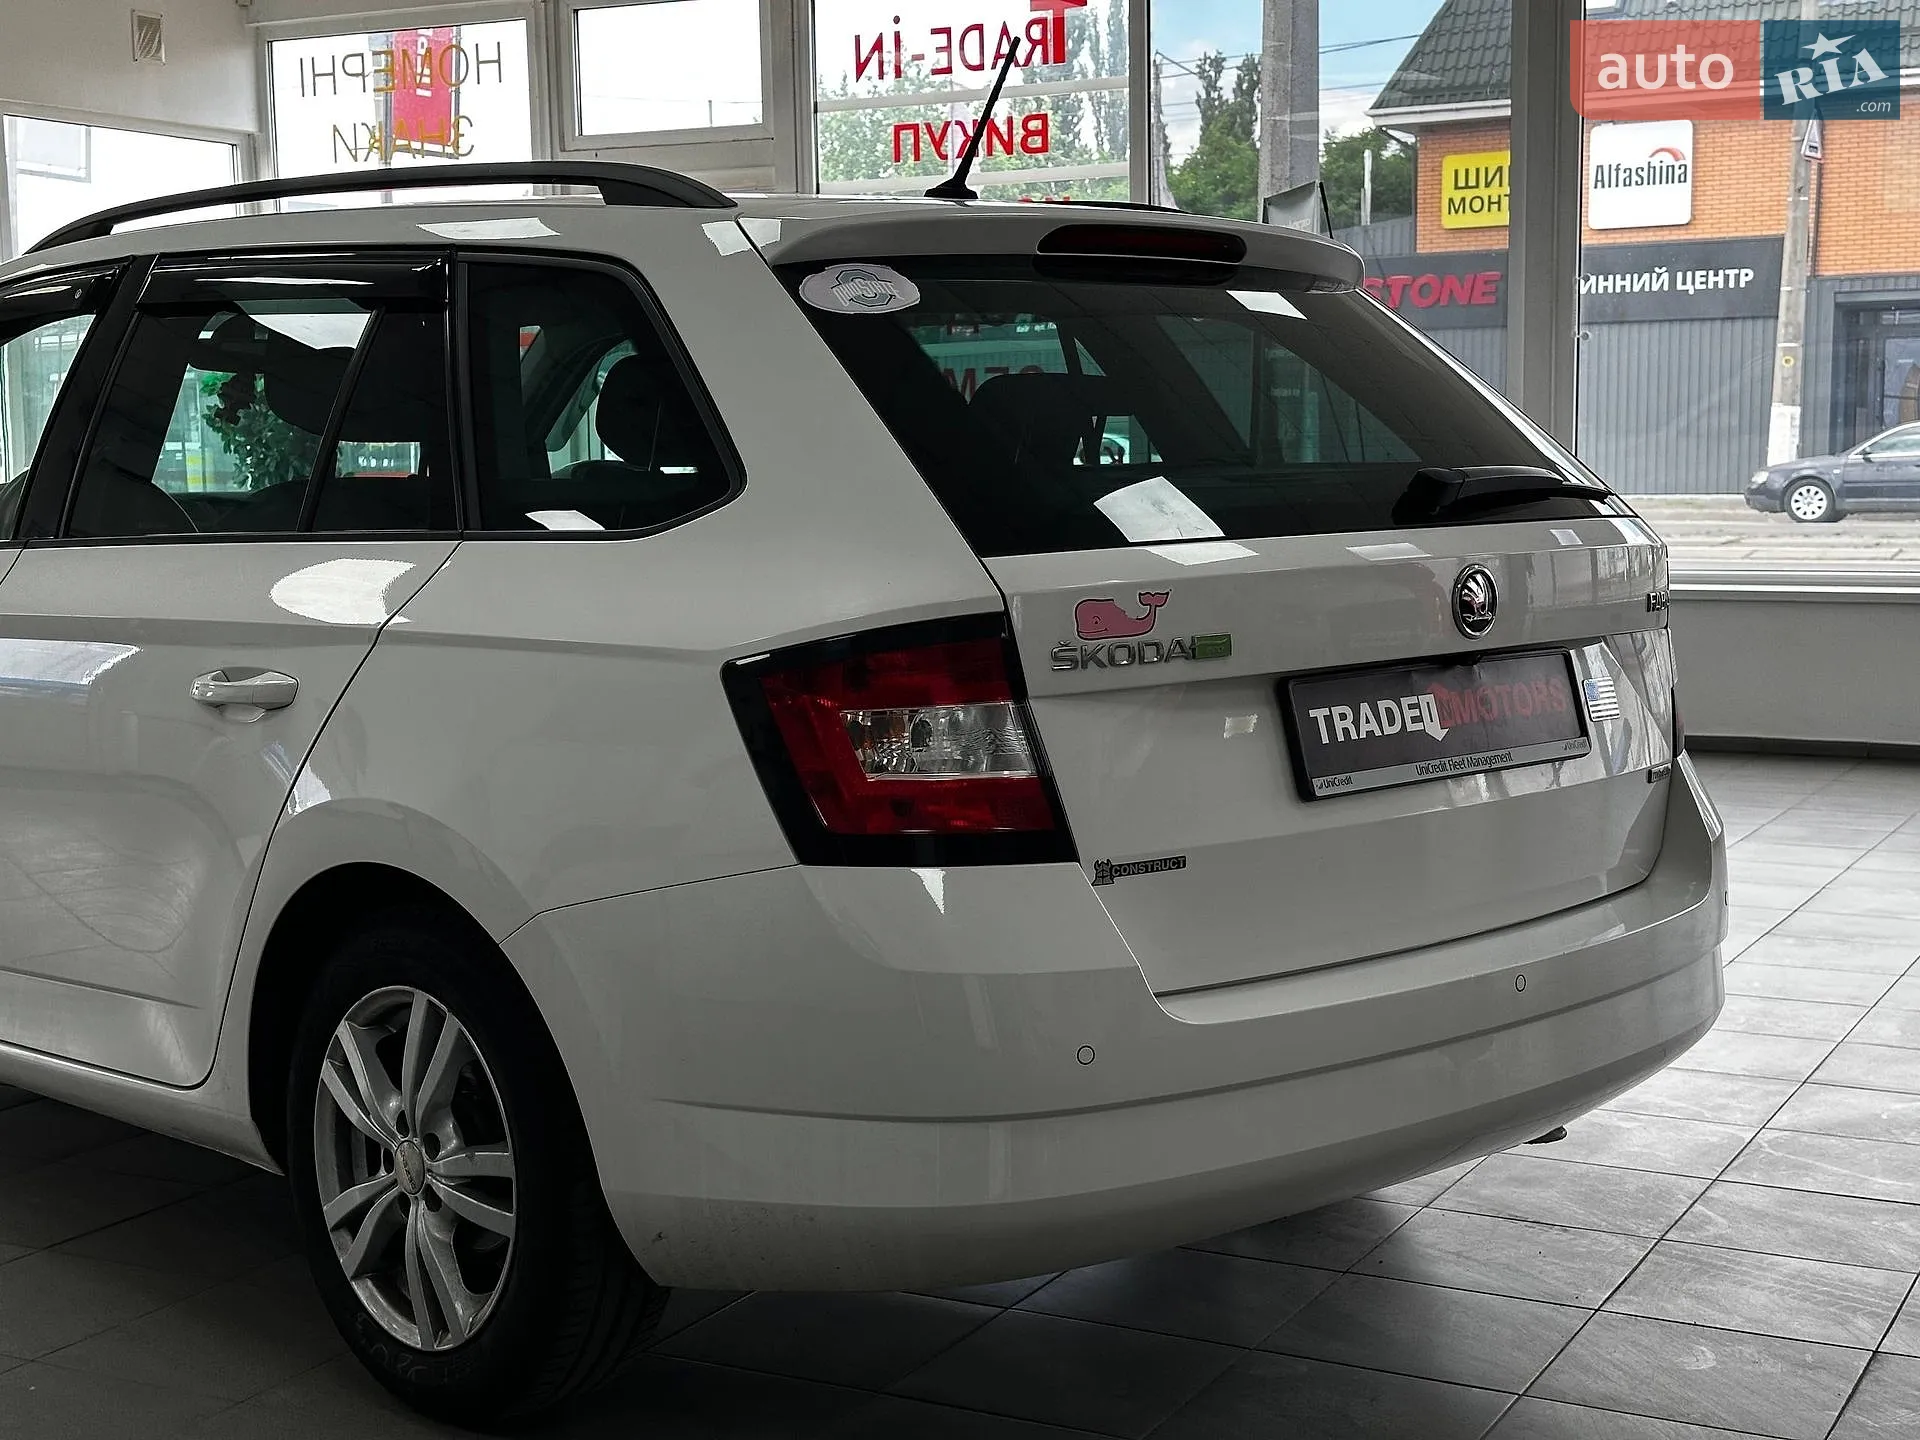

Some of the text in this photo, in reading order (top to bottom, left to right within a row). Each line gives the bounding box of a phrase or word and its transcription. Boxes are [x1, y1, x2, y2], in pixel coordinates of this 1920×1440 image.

[1453, 165, 1511, 191] ШИ
[1593, 160, 1688, 190] Alfashina
[1676, 269, 1755, 295] ЦЕНТР
[1051, 637, 1192, 672] ŠKODA
[1415, 751, 1514, 776] UniCredit Fleet Management
[1111, 857, 1186, 877] CONSTRUCT
